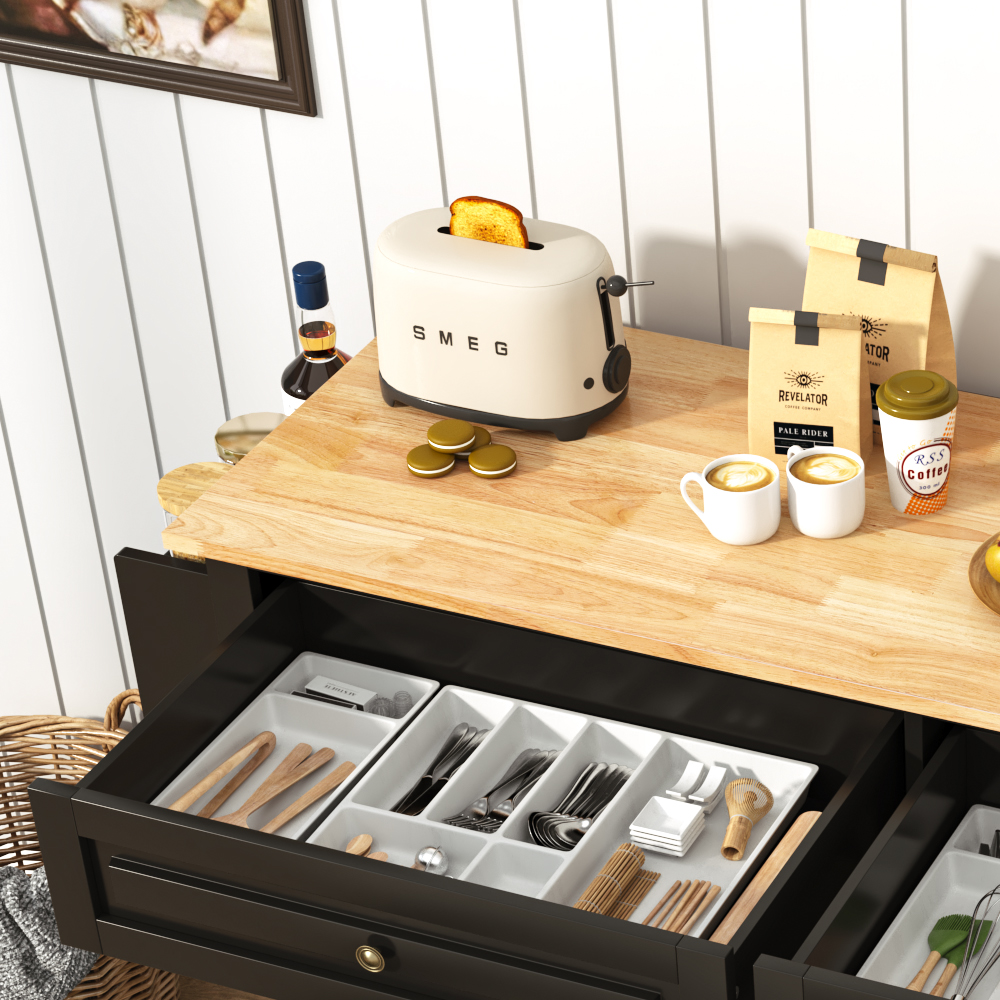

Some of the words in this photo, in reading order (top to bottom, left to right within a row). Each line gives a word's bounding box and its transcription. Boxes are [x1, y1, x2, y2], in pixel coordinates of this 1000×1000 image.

[412, 324, 508, 356] SMEG
[778, 389, 828, 407] REVELATOR
[778, 426, 799, 436] PALE
[801, 428, 828, 438] RIDER
[907, 463, 948, 480] Coffee
